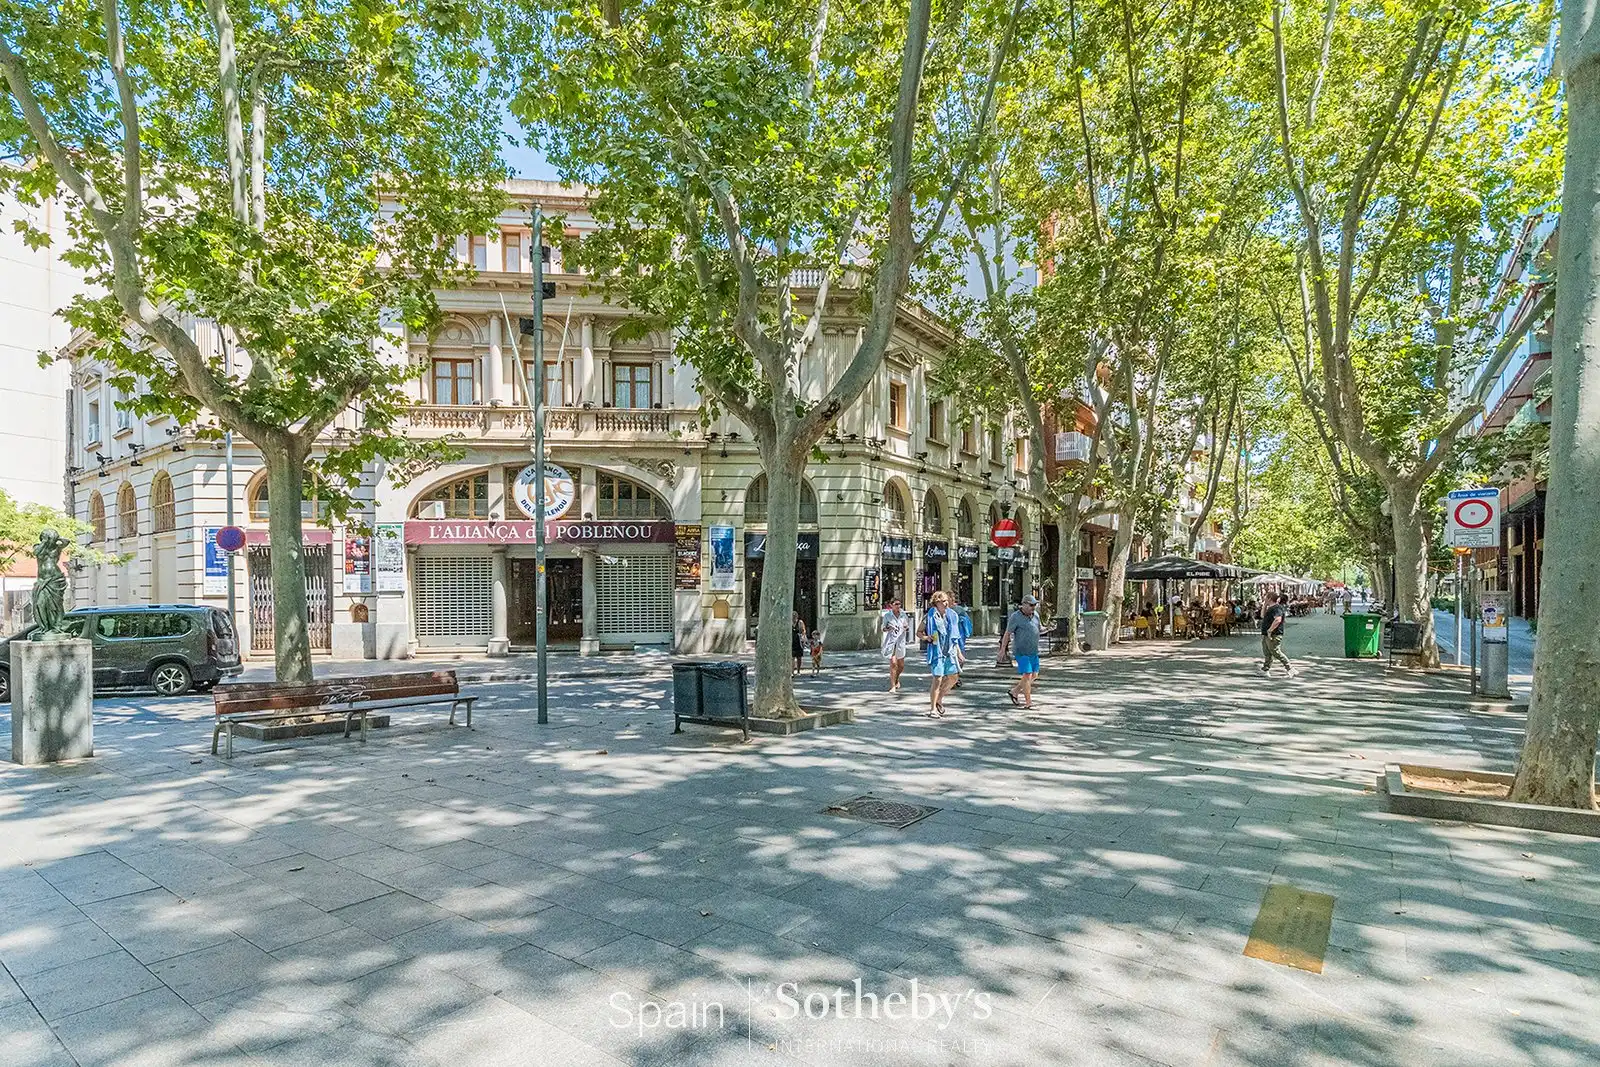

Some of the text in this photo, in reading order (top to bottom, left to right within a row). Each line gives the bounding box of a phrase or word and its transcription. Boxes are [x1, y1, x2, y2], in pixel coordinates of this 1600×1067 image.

[521, 499, 568, 516] DEL LENOU
[429, 524, 652, 542] L'ALIANÇA dl POBLENOU
